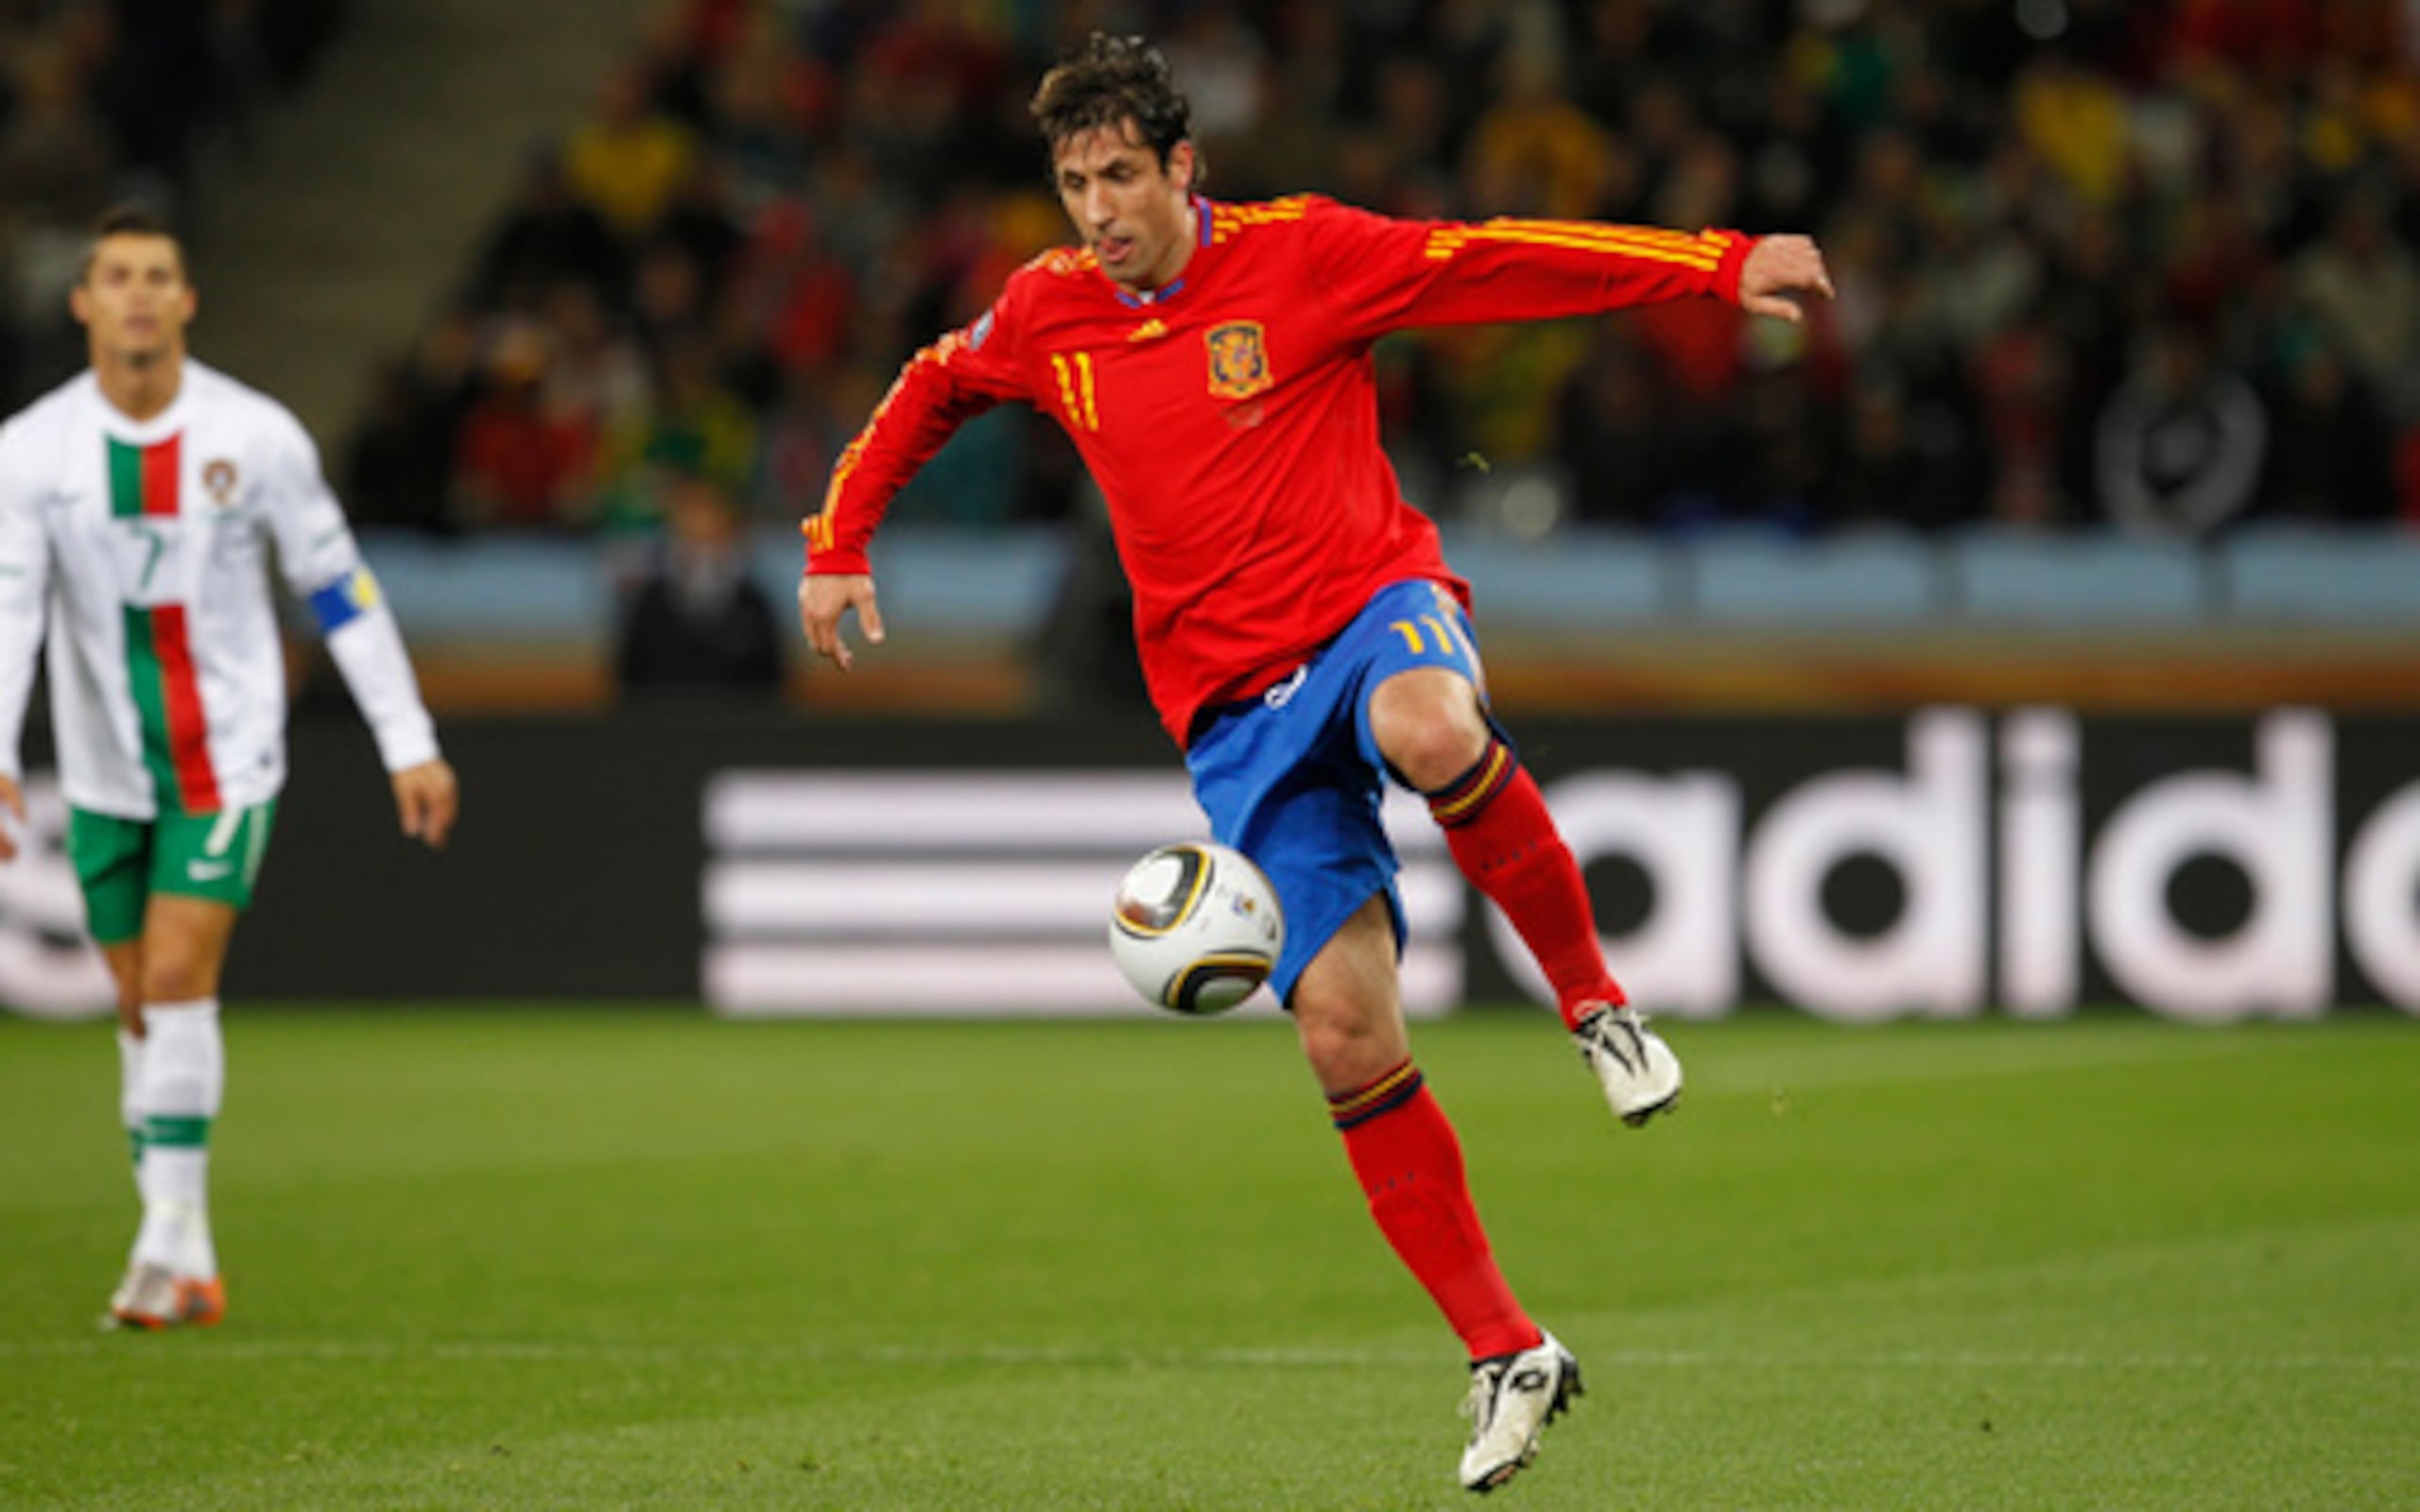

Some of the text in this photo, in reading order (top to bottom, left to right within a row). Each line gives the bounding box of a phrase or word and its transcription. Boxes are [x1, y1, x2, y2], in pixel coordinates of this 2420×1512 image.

[1051, 352, 1098, 431] 11
[130, 521, 164, 592] 7
[1390, 614, 1453, 654] 11
